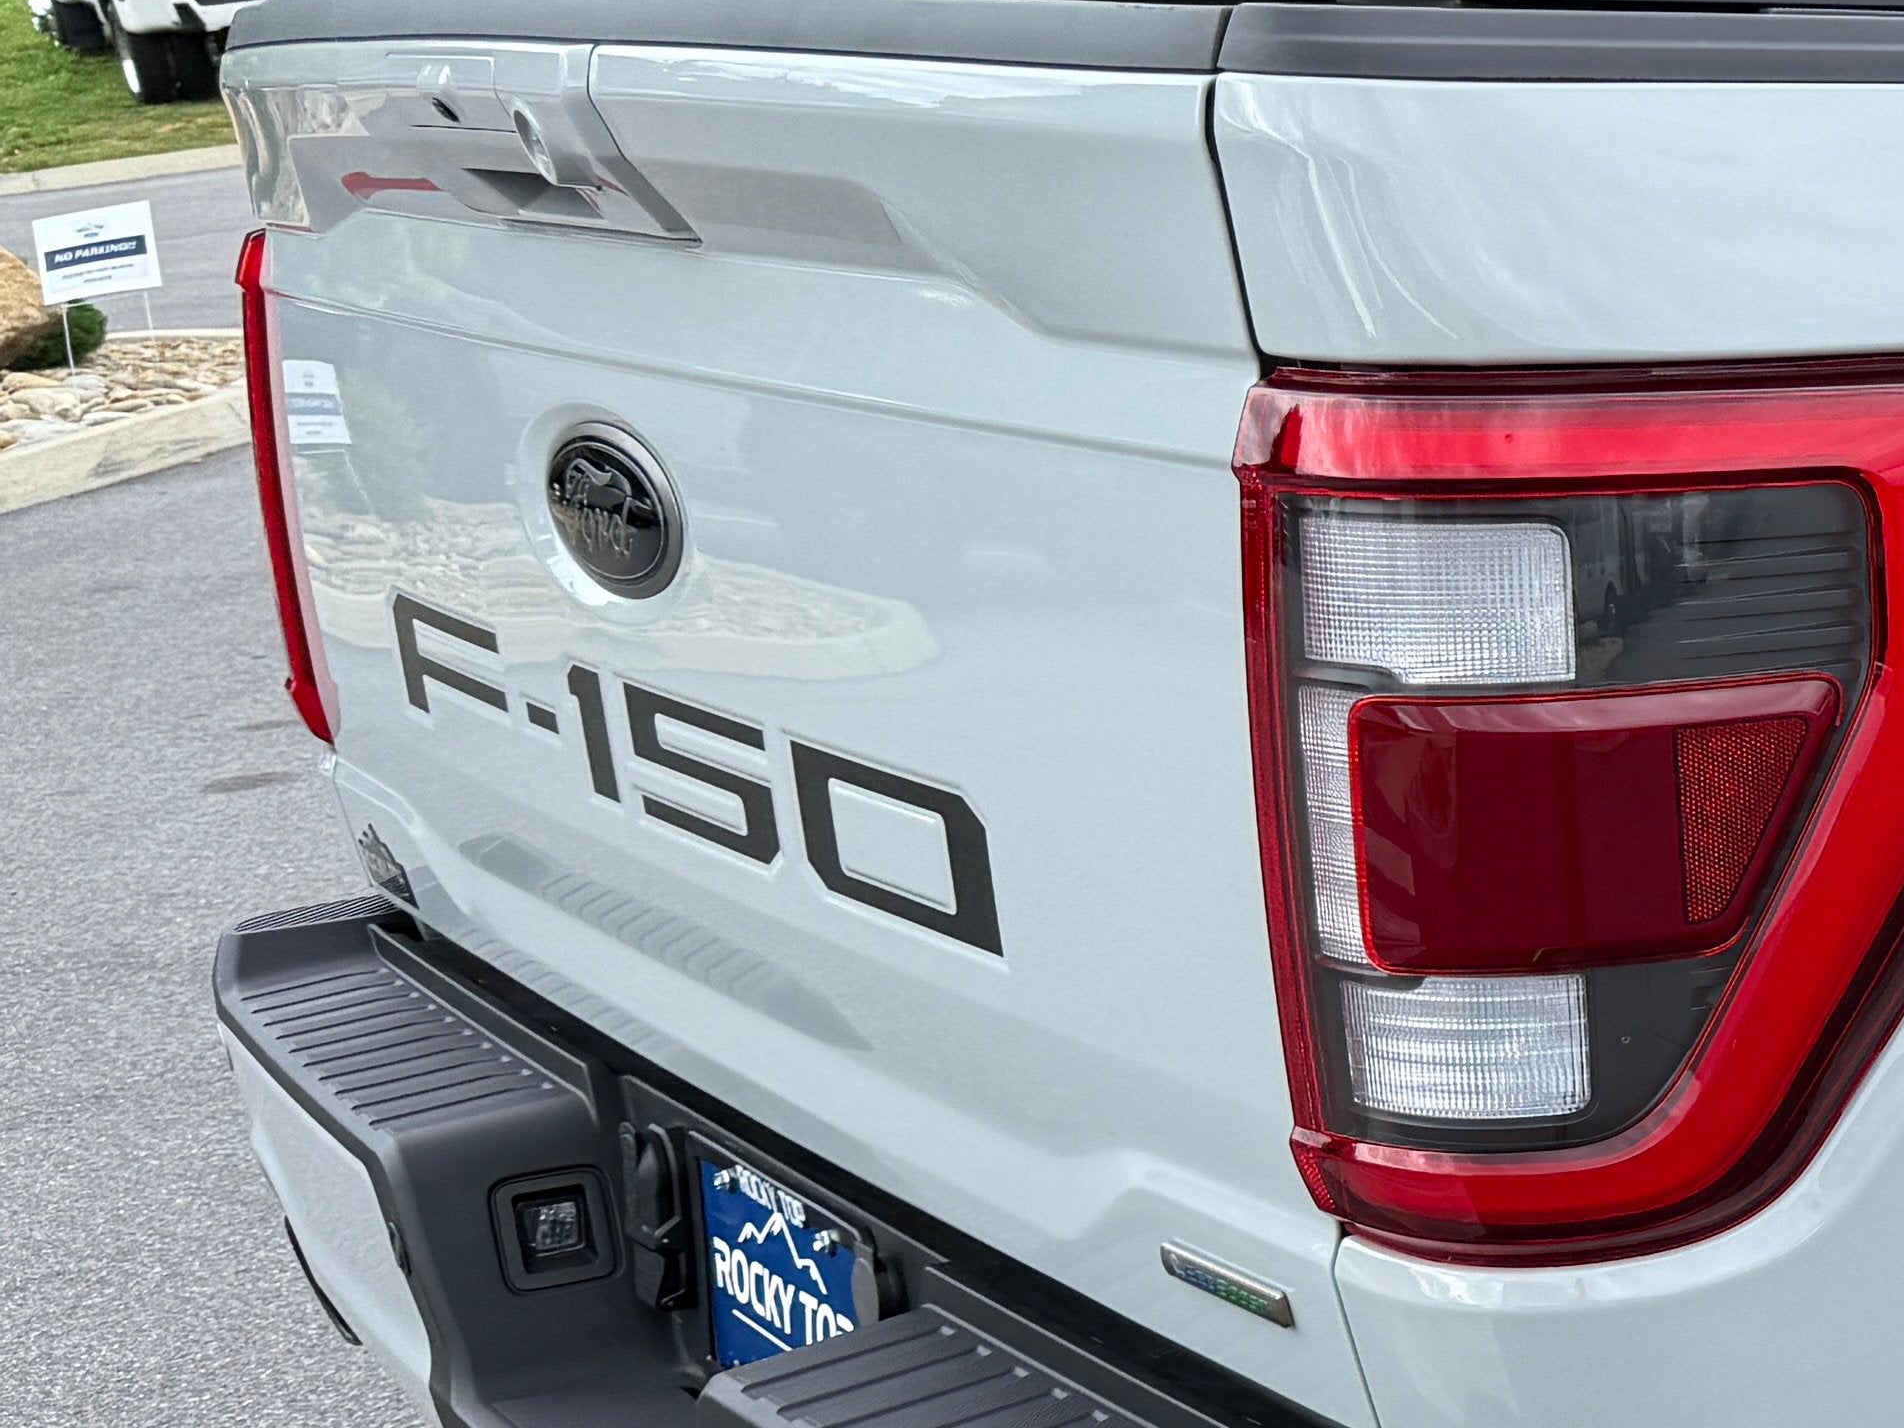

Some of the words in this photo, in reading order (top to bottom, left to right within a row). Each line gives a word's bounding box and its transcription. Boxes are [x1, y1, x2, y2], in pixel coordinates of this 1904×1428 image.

[54, 251, 73, 264] NO
[391, 591, 1005, 959] F-150
[712, 1235, 796, 1335] ROCKY
